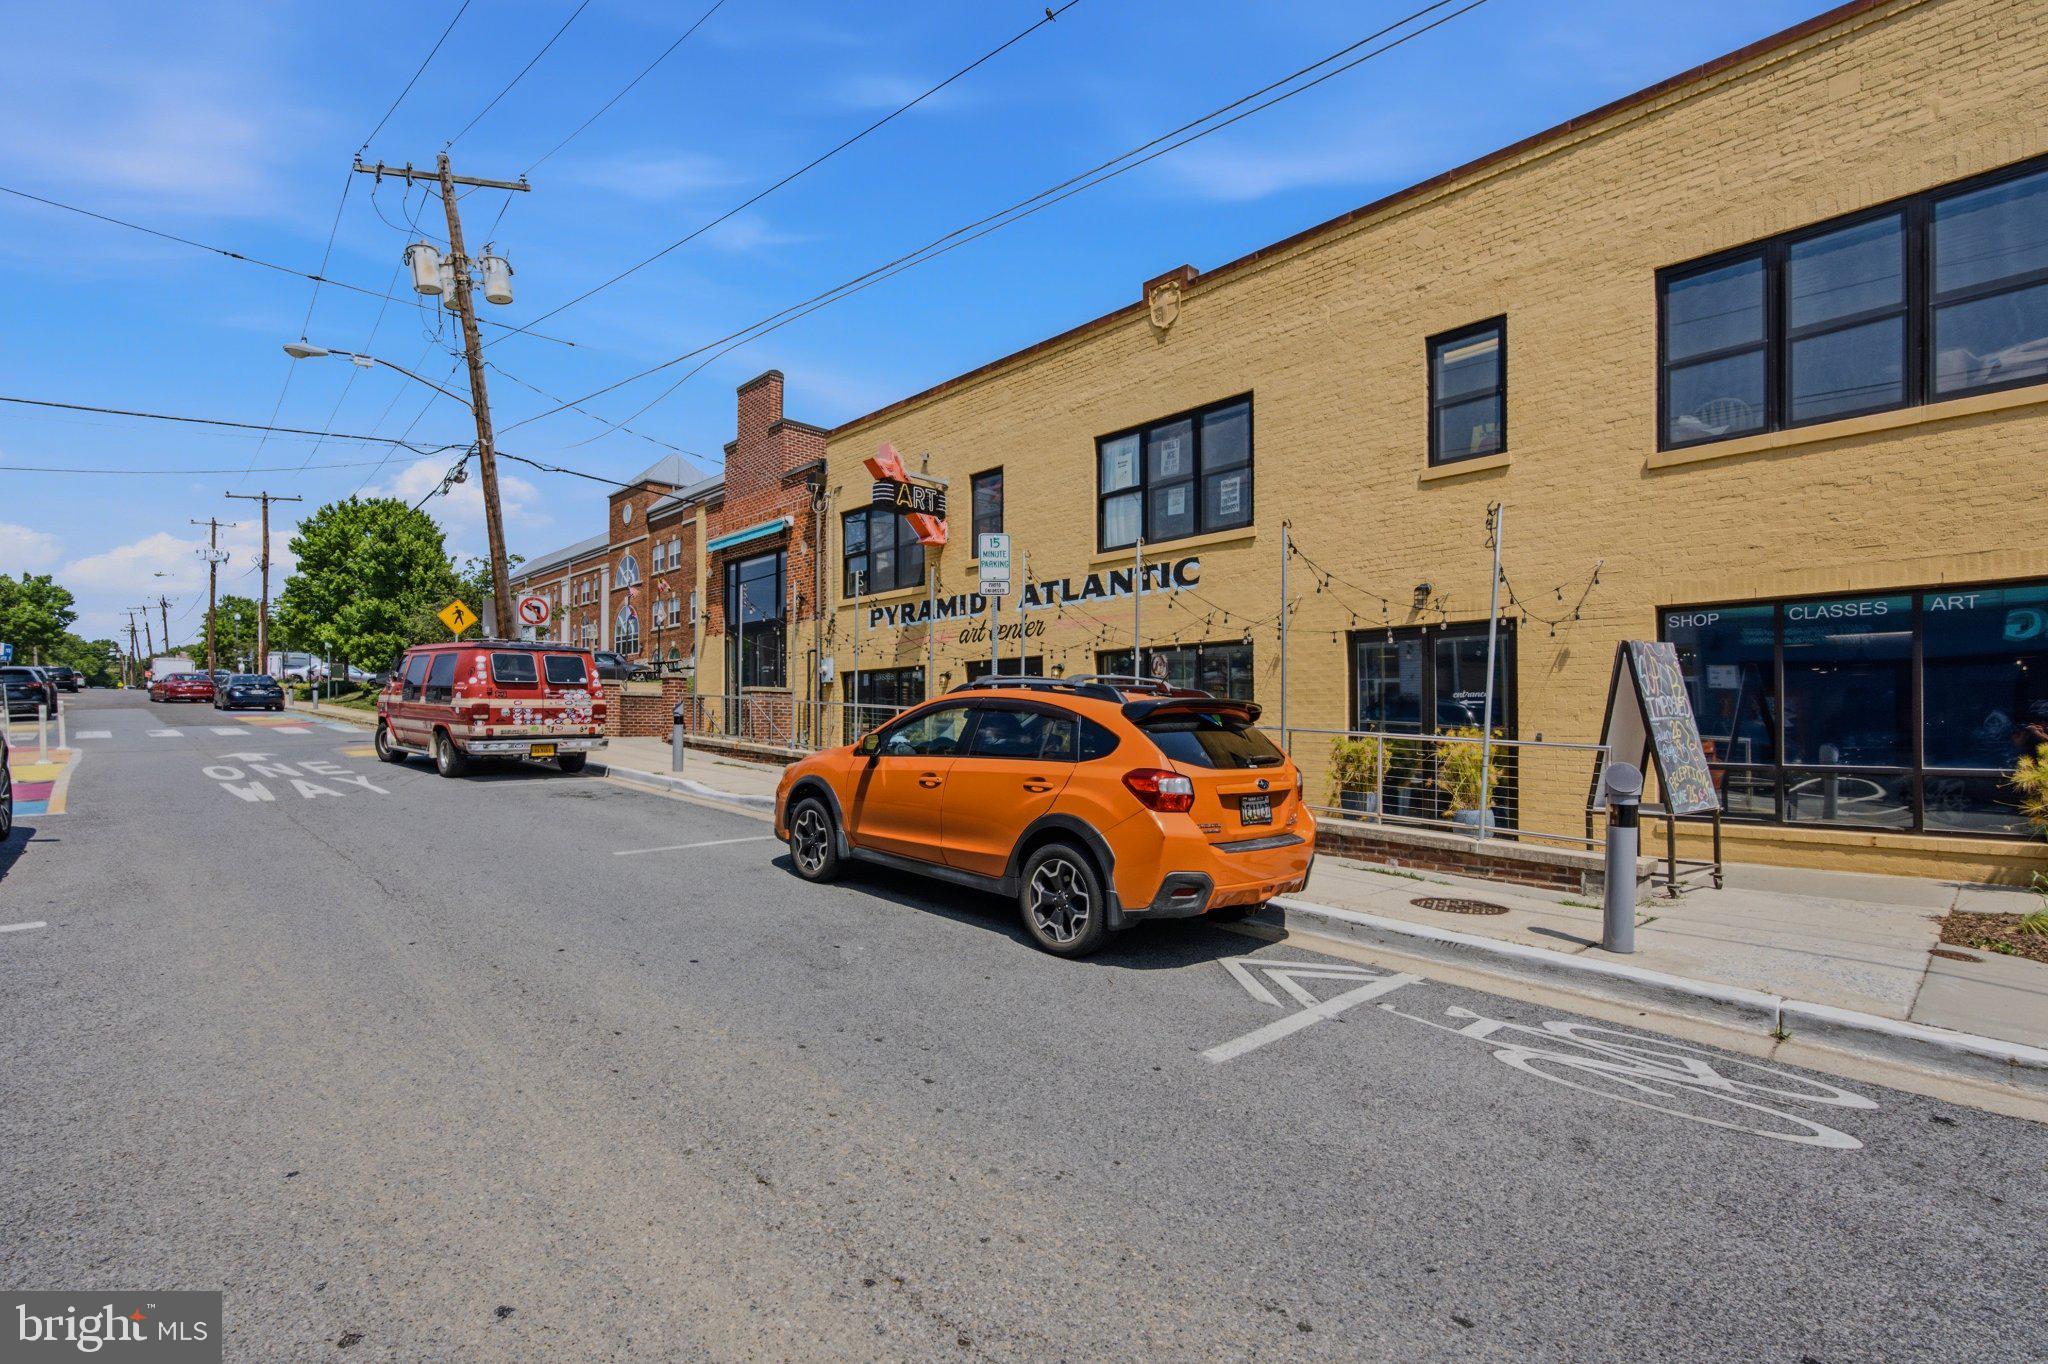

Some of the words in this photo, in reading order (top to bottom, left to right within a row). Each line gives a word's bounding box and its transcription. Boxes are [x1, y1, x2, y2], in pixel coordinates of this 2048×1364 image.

[896, 483, 937, 511] ART
[990, 537, 1000, 548] 15
[982, 550, 1007, 558] MINUTE
[981, 560, 1010, 568] PARKING
[869, 592, 987, 630] PYRAMID
[1017, 556, 1201, 610] ATLANTIC
[1930, 594, 1980, 611] ART
[1788, 601, 1888, 620] CLASSES
[1668, 613, 1720, 628] SHOP
[959, 619, 986, 644] art
[1453, 690, 1487, 698] entranc
[202, 761, 355, 780] ONE
[1669, 765, 1710, 793] RECEPTION
[219, 776, 391, 802] WAY
[1686, 784, 1699, 803] 26
